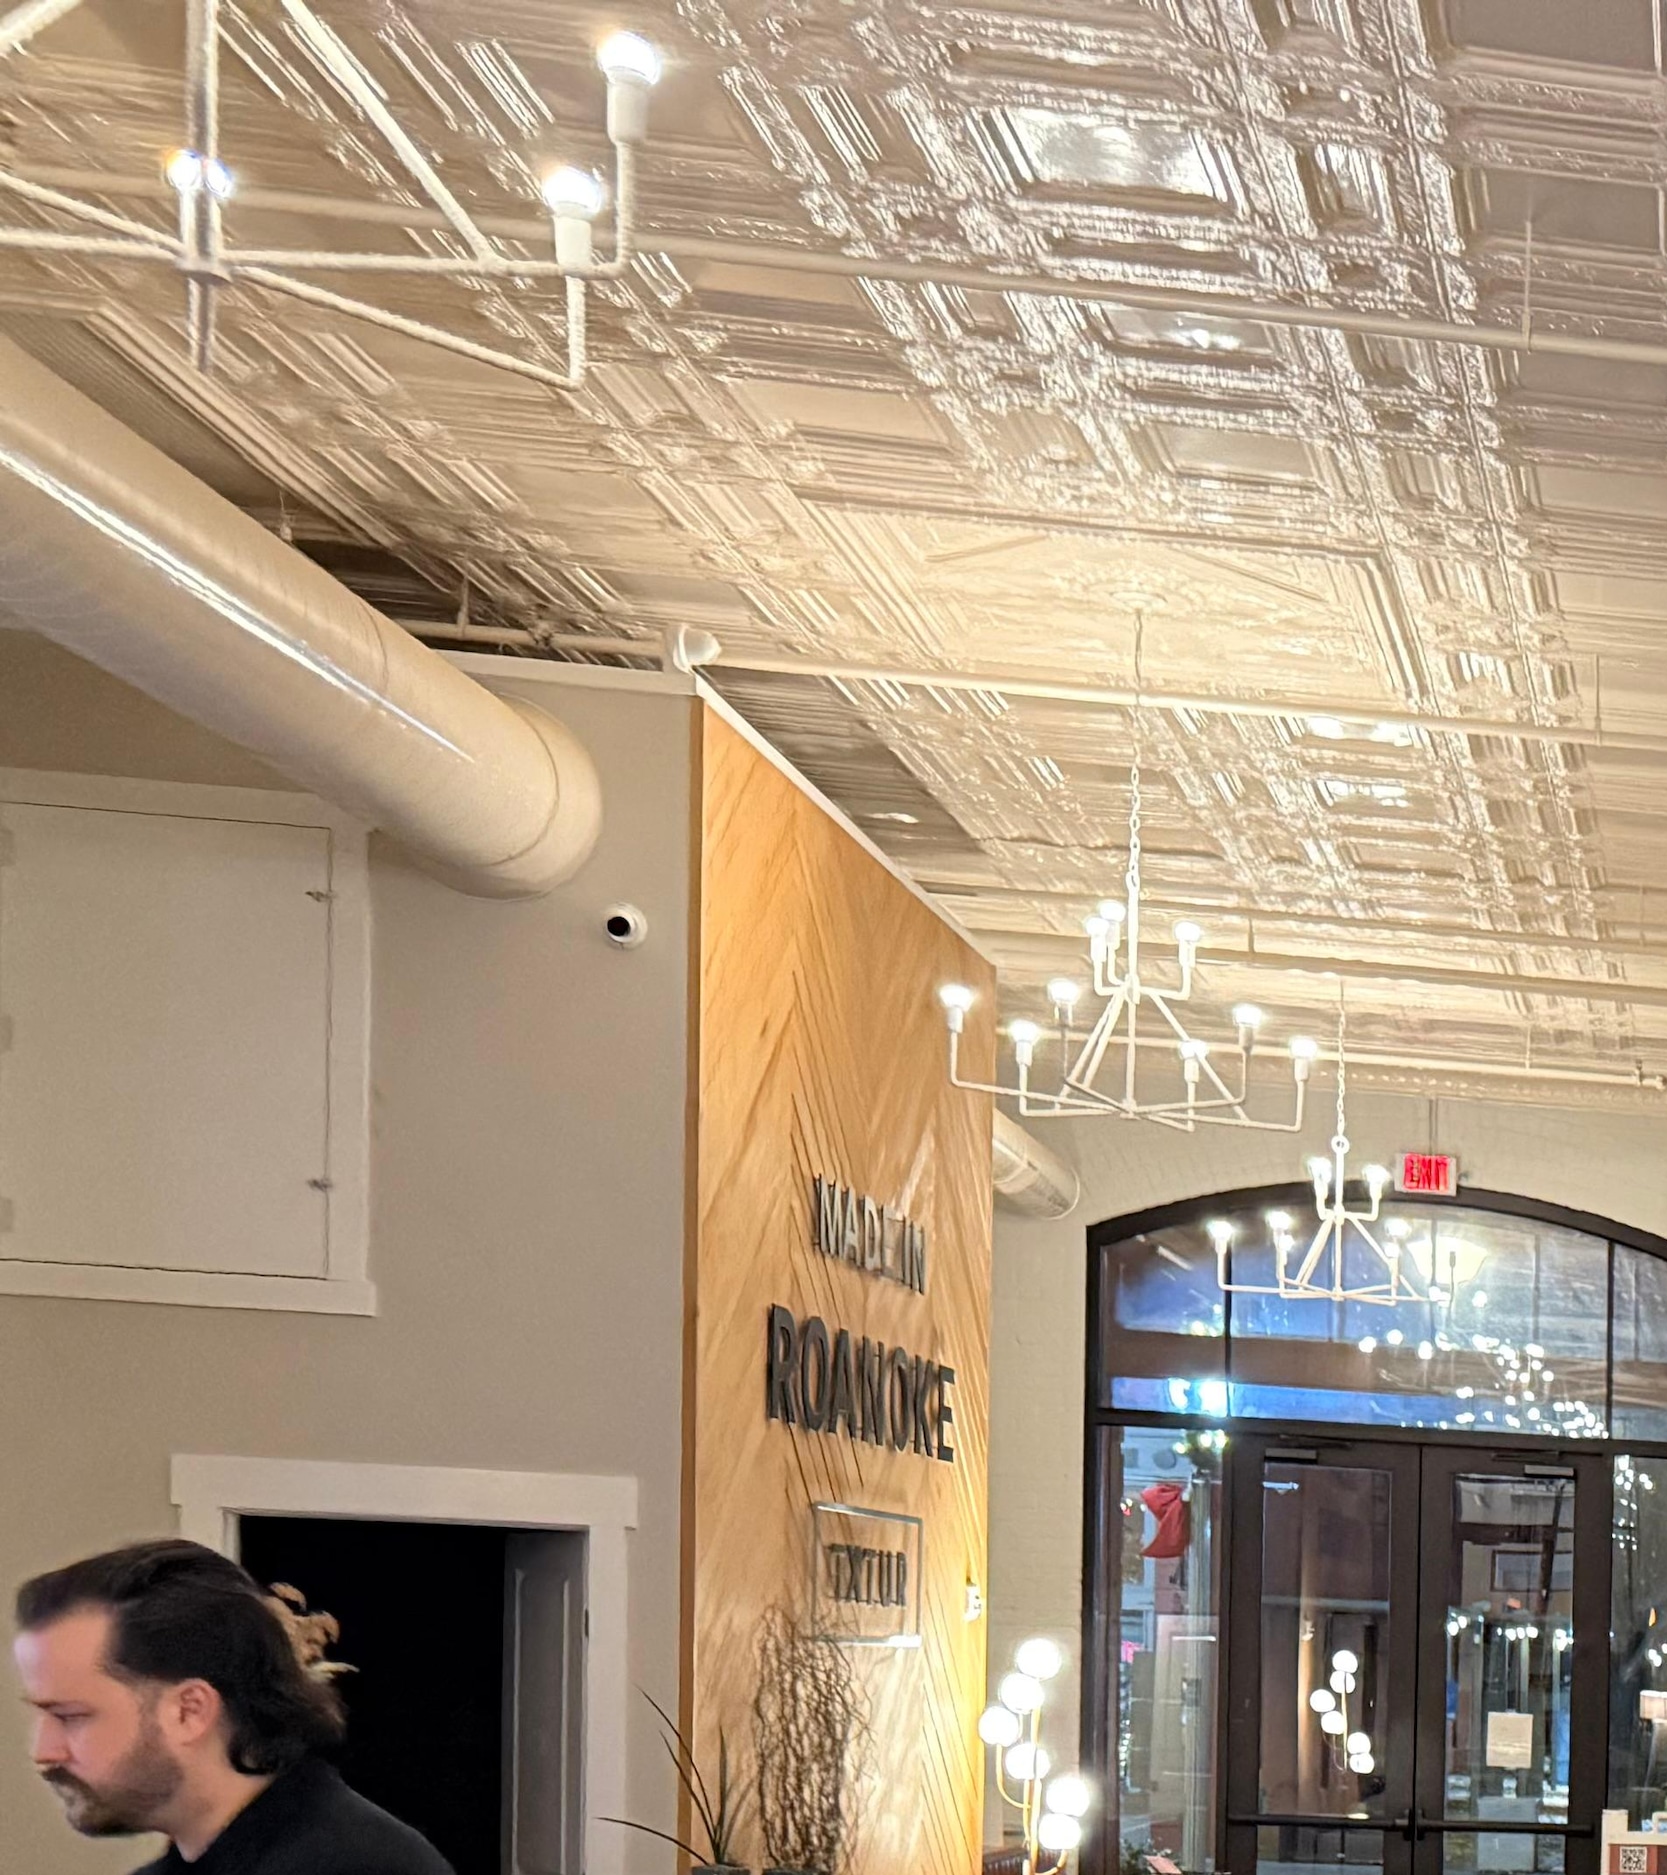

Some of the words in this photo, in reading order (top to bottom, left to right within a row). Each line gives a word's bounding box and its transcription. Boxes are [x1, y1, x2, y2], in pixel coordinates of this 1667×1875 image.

[1403, 1154, 1450, 1191] EXIT
[814, 1174, 901, 1280] MADE
[902, 1216, 926, 1295] IN
[768, 1303, 955, 1462] ROANOKE
[830, 1543, 907, 1607] TXTUR
